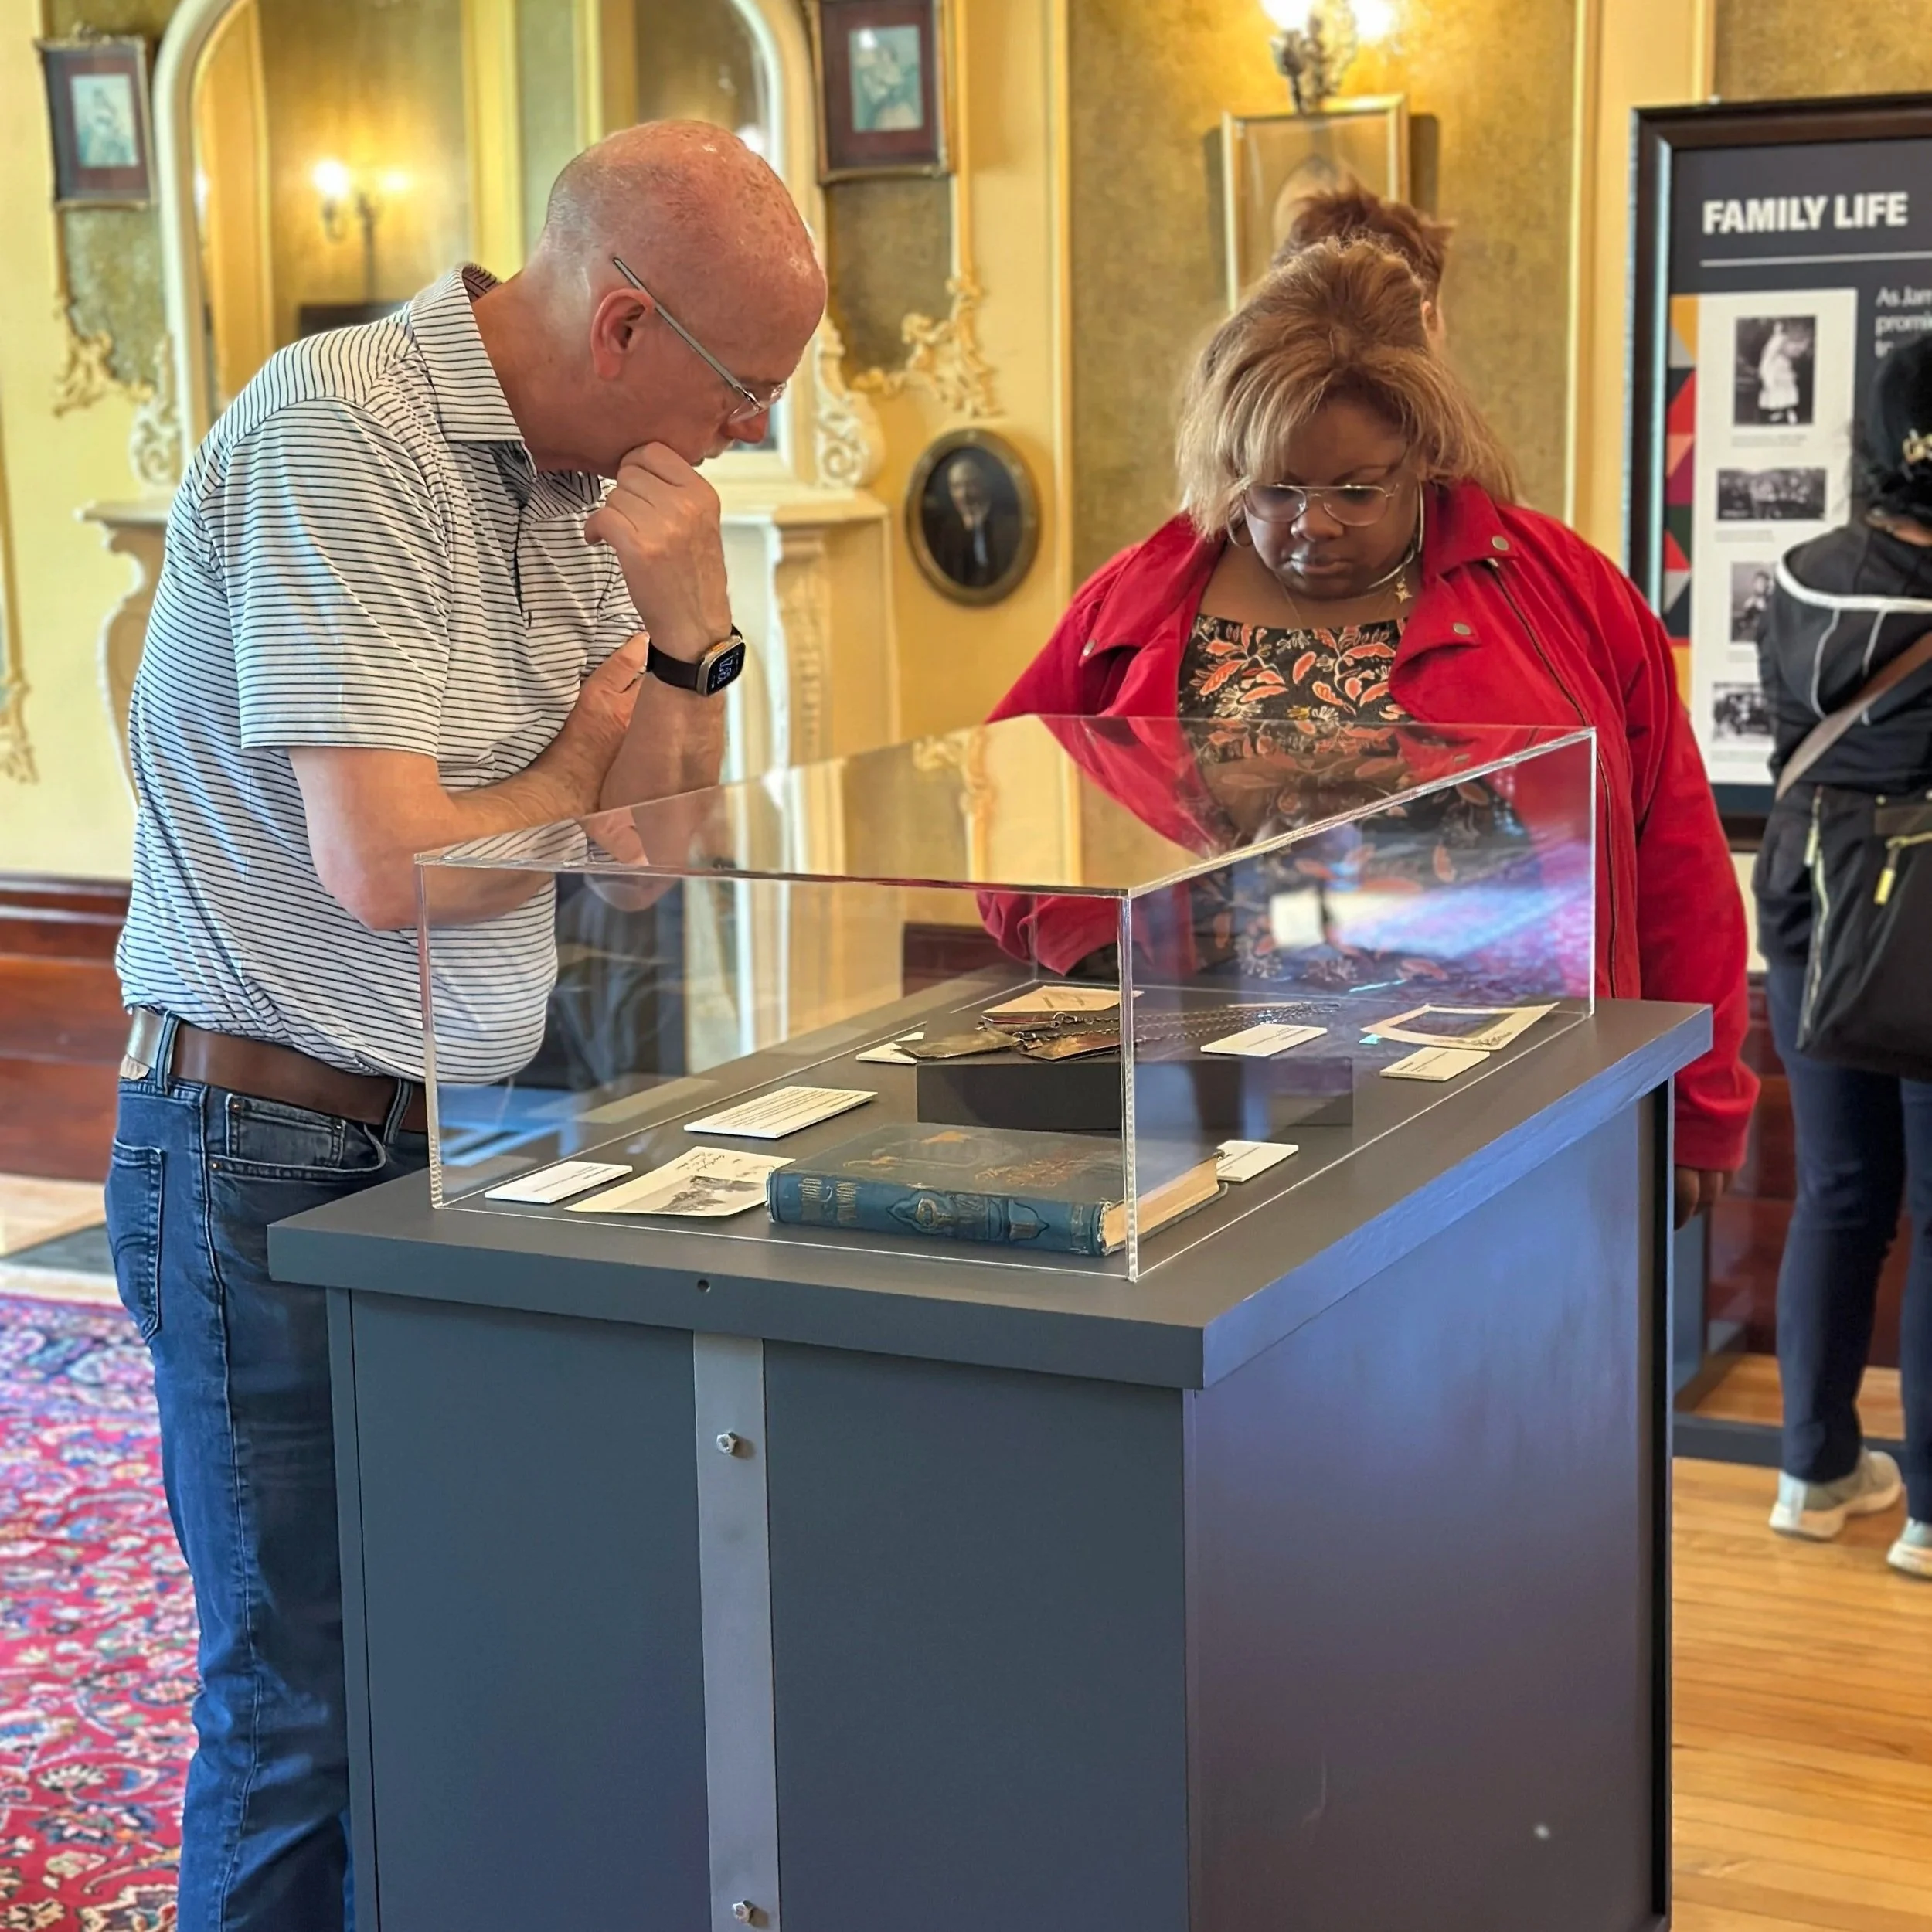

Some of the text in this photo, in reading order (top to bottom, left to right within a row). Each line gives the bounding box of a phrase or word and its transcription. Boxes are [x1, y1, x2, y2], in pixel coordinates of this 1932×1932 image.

[1702, 191, 1908, 235] FAMILY LIFE
[1876, 286, 1900, 308] As
